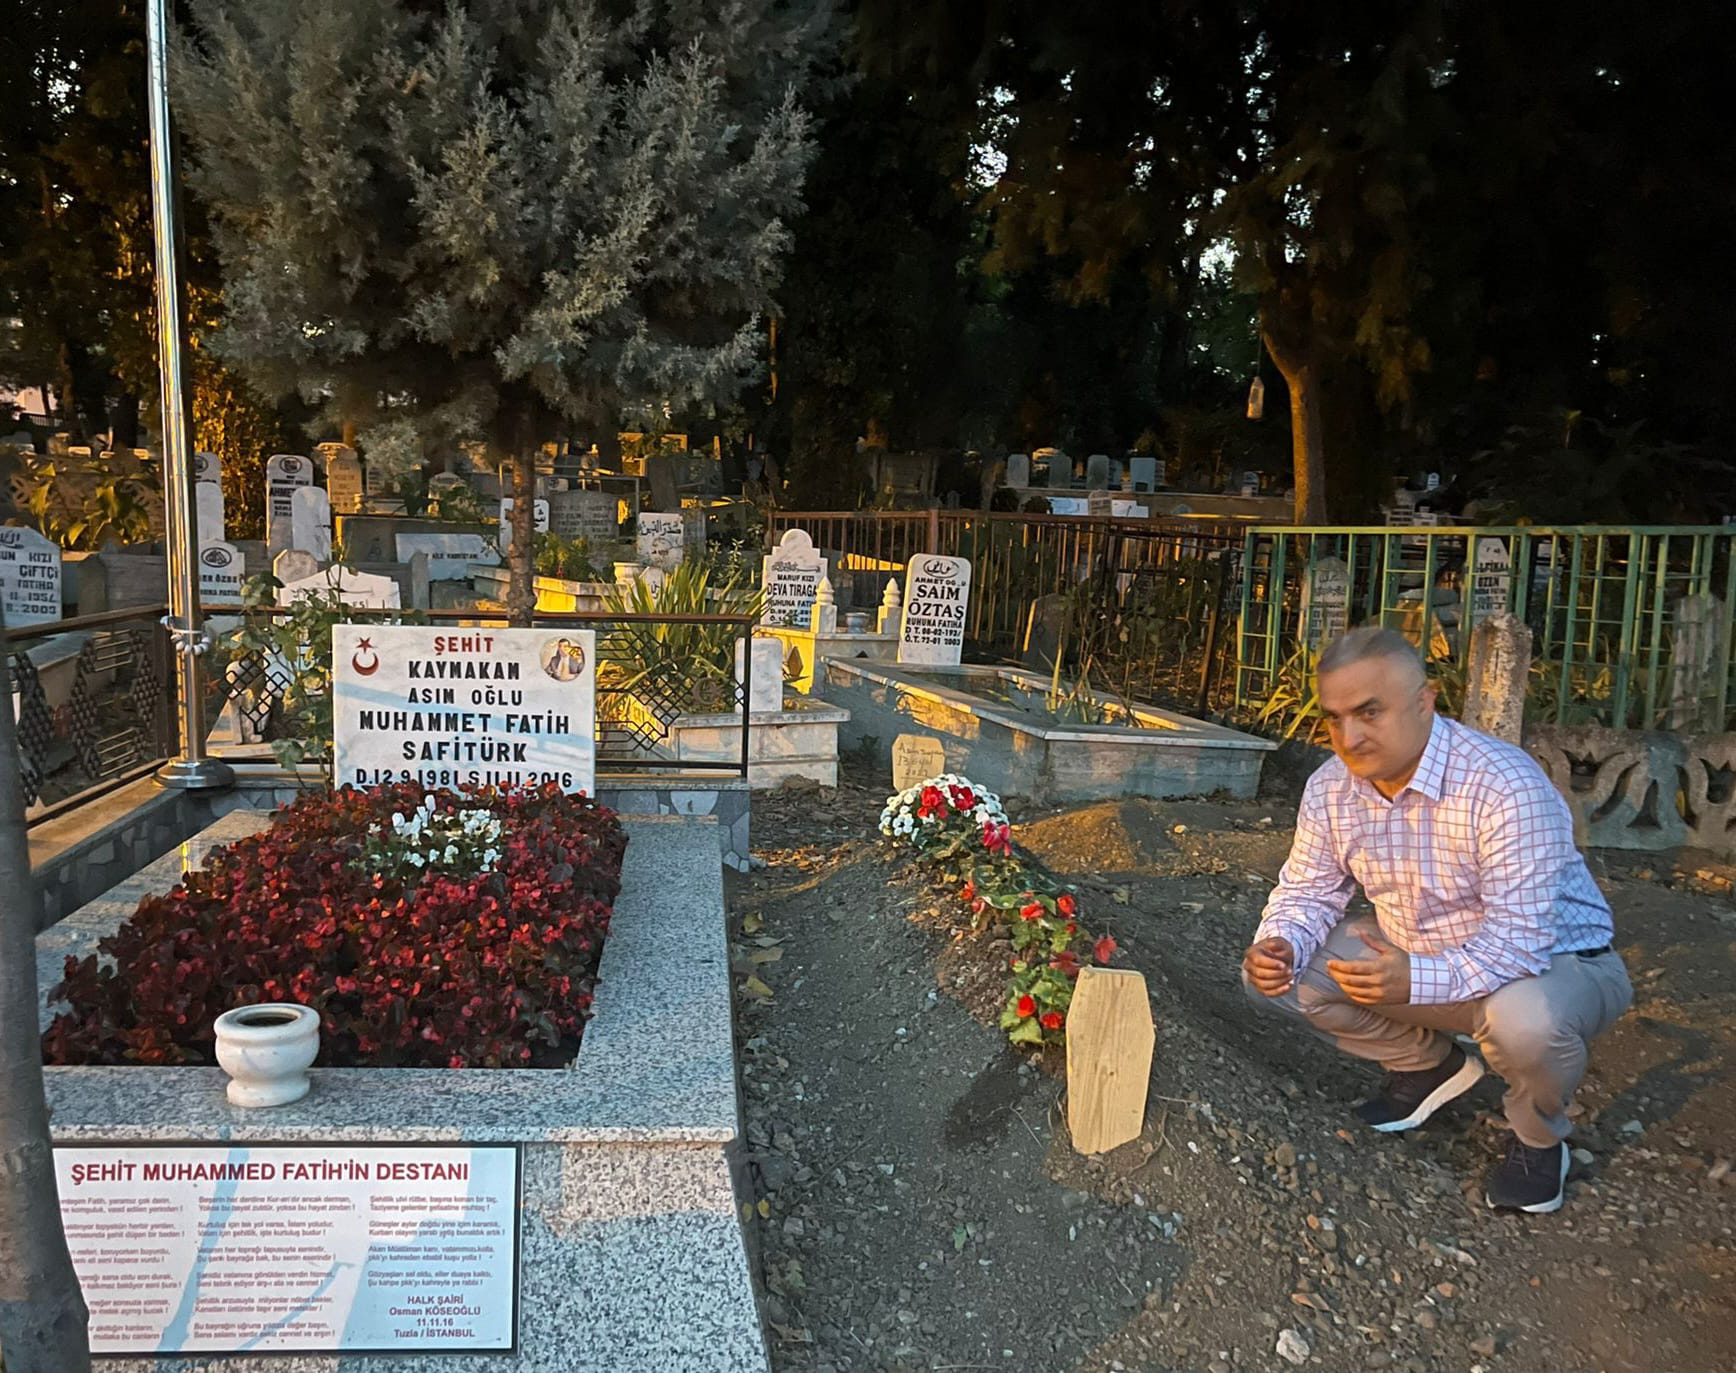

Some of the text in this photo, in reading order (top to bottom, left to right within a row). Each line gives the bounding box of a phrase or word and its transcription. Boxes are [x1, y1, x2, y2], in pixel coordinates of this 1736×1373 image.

[916, 584, 961, 601] SAİM
[908, 598, 965, 620] ÖZTAŞ
[434, 632, 494, 656] ŞEHİT
[408, 660, 520, 680] KAYMAKAM
[408, 685, 523, 706] ASIM OĞLU
[359, 709, 570, 734] MUHAMMET FATİH
[402, 736, 528, 763] SAFİTÜRK
[71, 1159, 469, 1185] ŞEHİT MUHAMMED FATİH'İN DESTANI
[407, 1294, 464, 1305] HALK ŞAİRİ
[389, 1305, 481, 1316] Osman KÖSEOĞLU
[416, 1318, 454, 1326] 11.11.16
[394, 1329, 419, 1338] Tuzla
[426, 1327, 475, 1338] İSTANBUL
